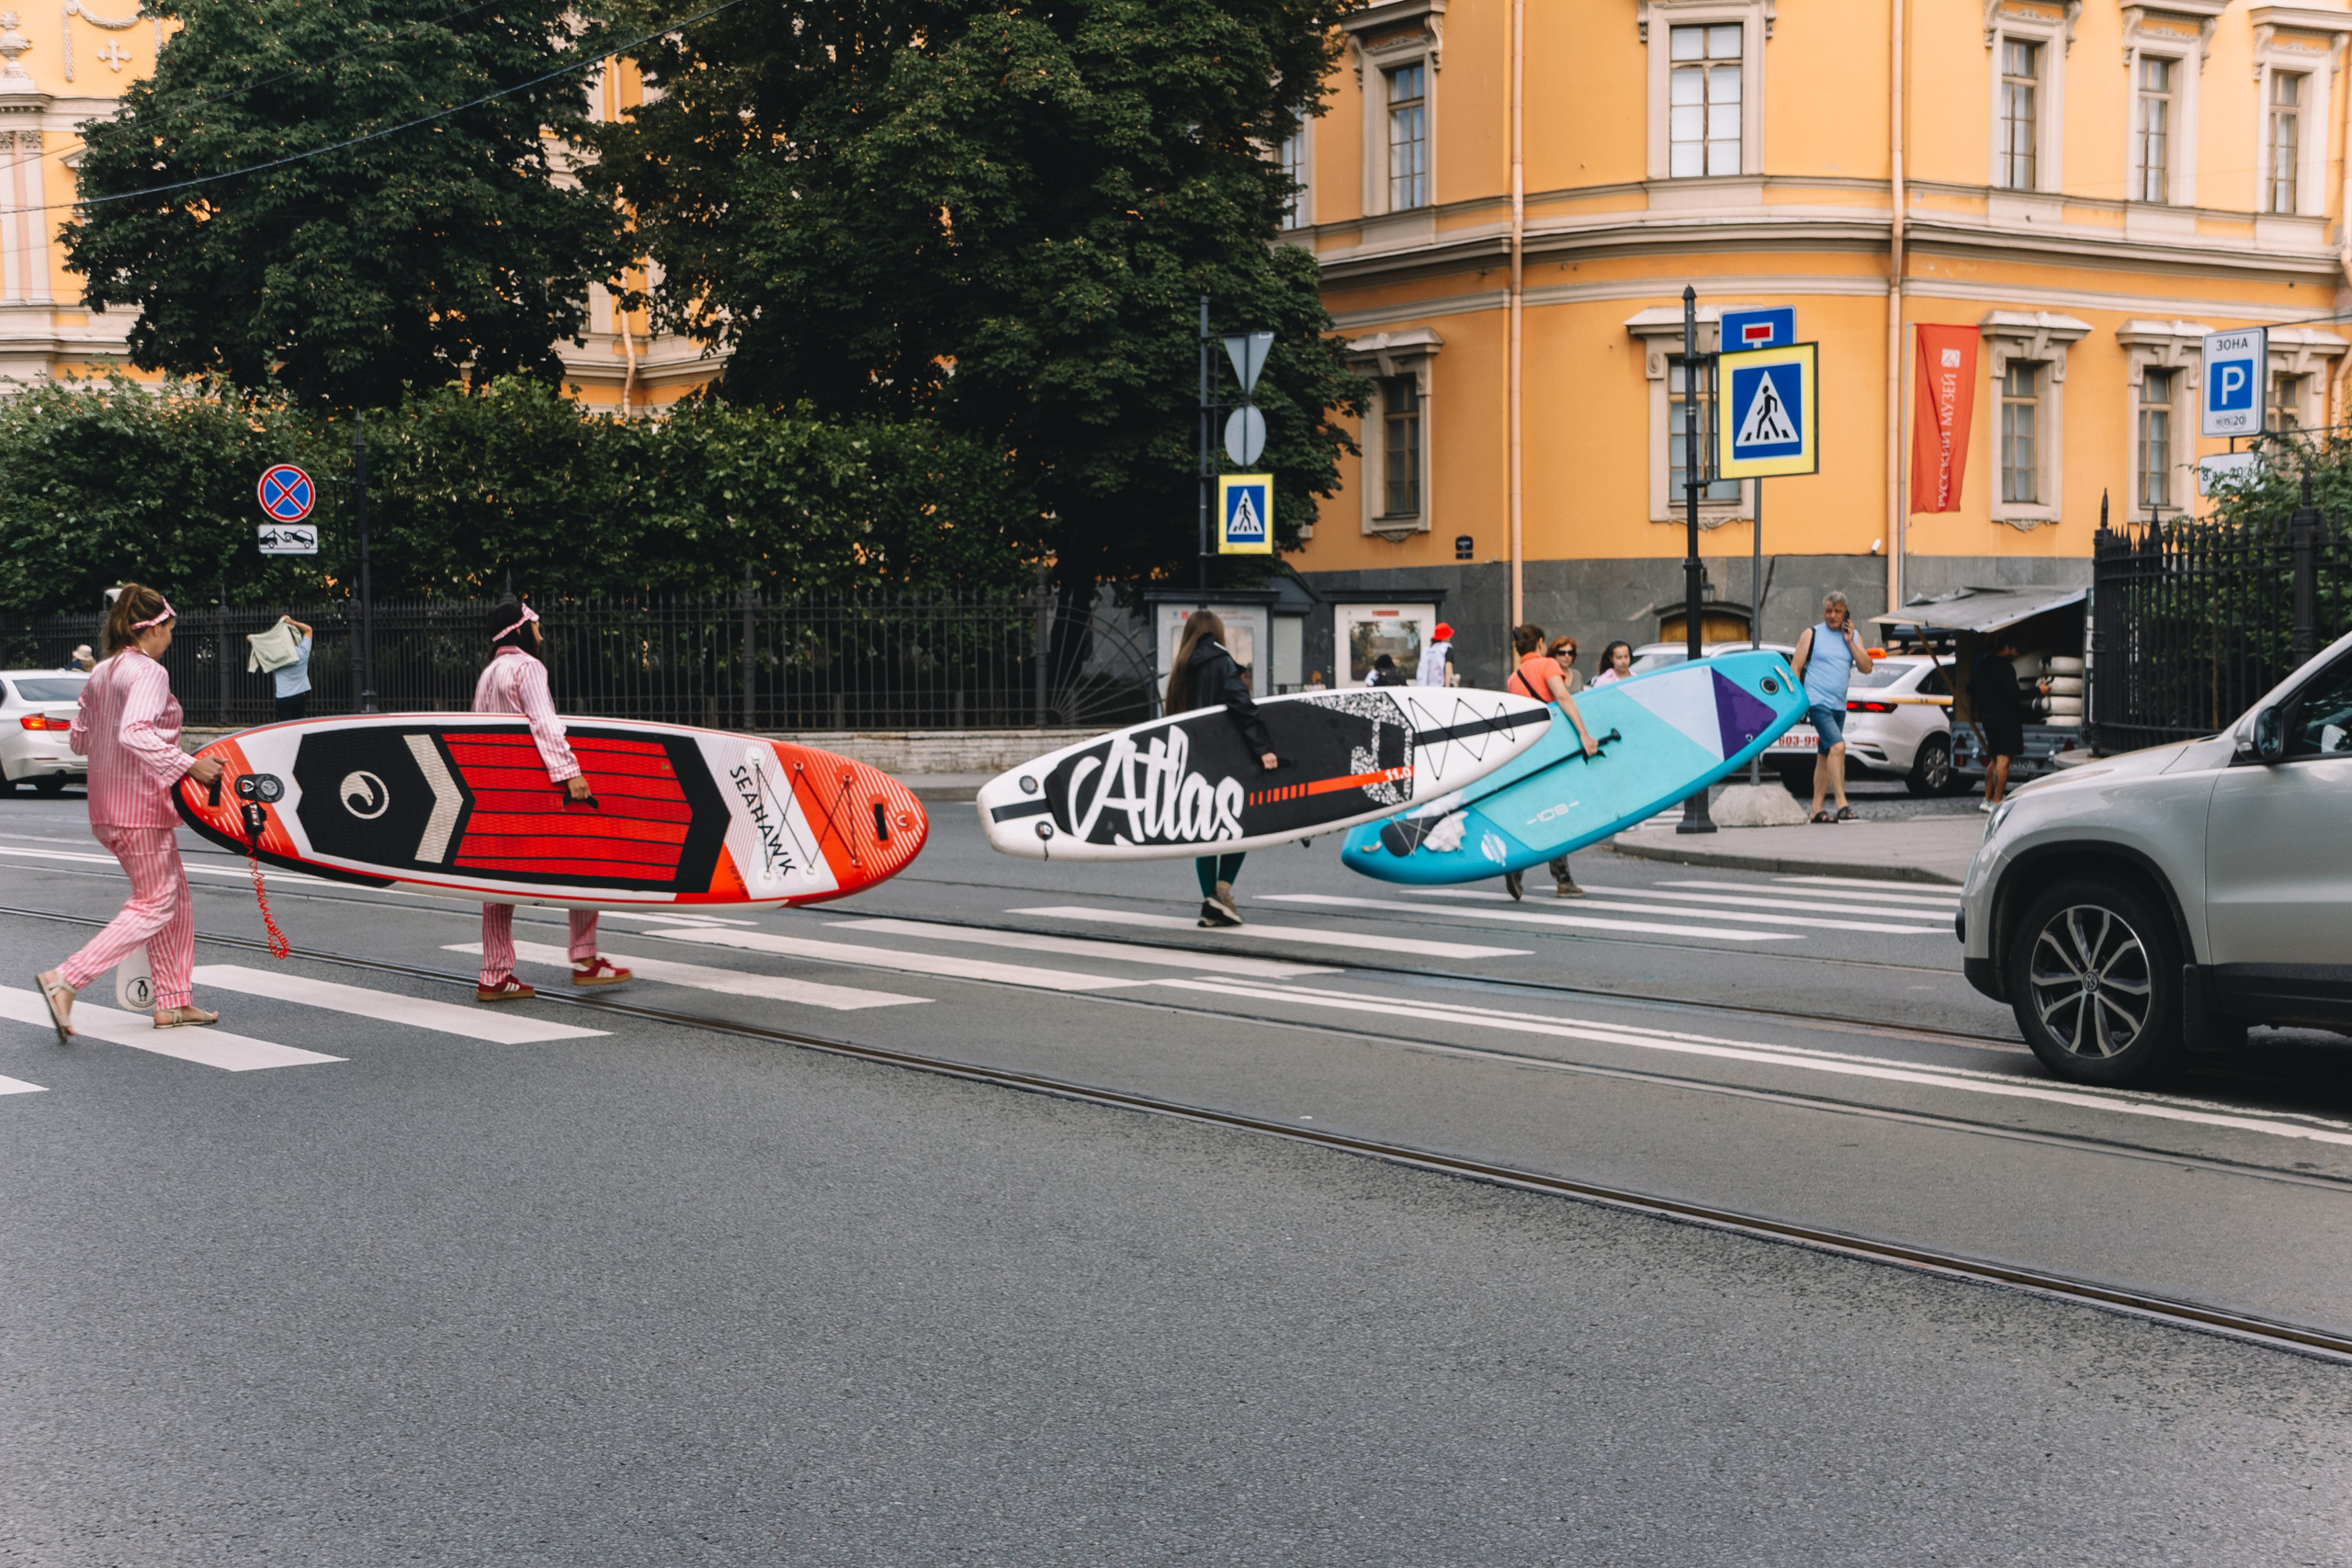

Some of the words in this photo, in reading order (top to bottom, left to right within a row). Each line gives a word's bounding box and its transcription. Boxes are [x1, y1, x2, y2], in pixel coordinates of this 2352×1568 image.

[2216, 338, 2248, 351] ЗОНА
[2221, 366, 2245, 405] P
[1940, 373, 1957, 426] МУЗЕЙ
[2233, 415, 2245, 426] 20
[1068, 724, 1245, 846] Atlas
[1385, 766, 1412, 782] 11.0
[729, 765, 797, 876] SEAHAWK
[737, 882, 748, 898] AIR
